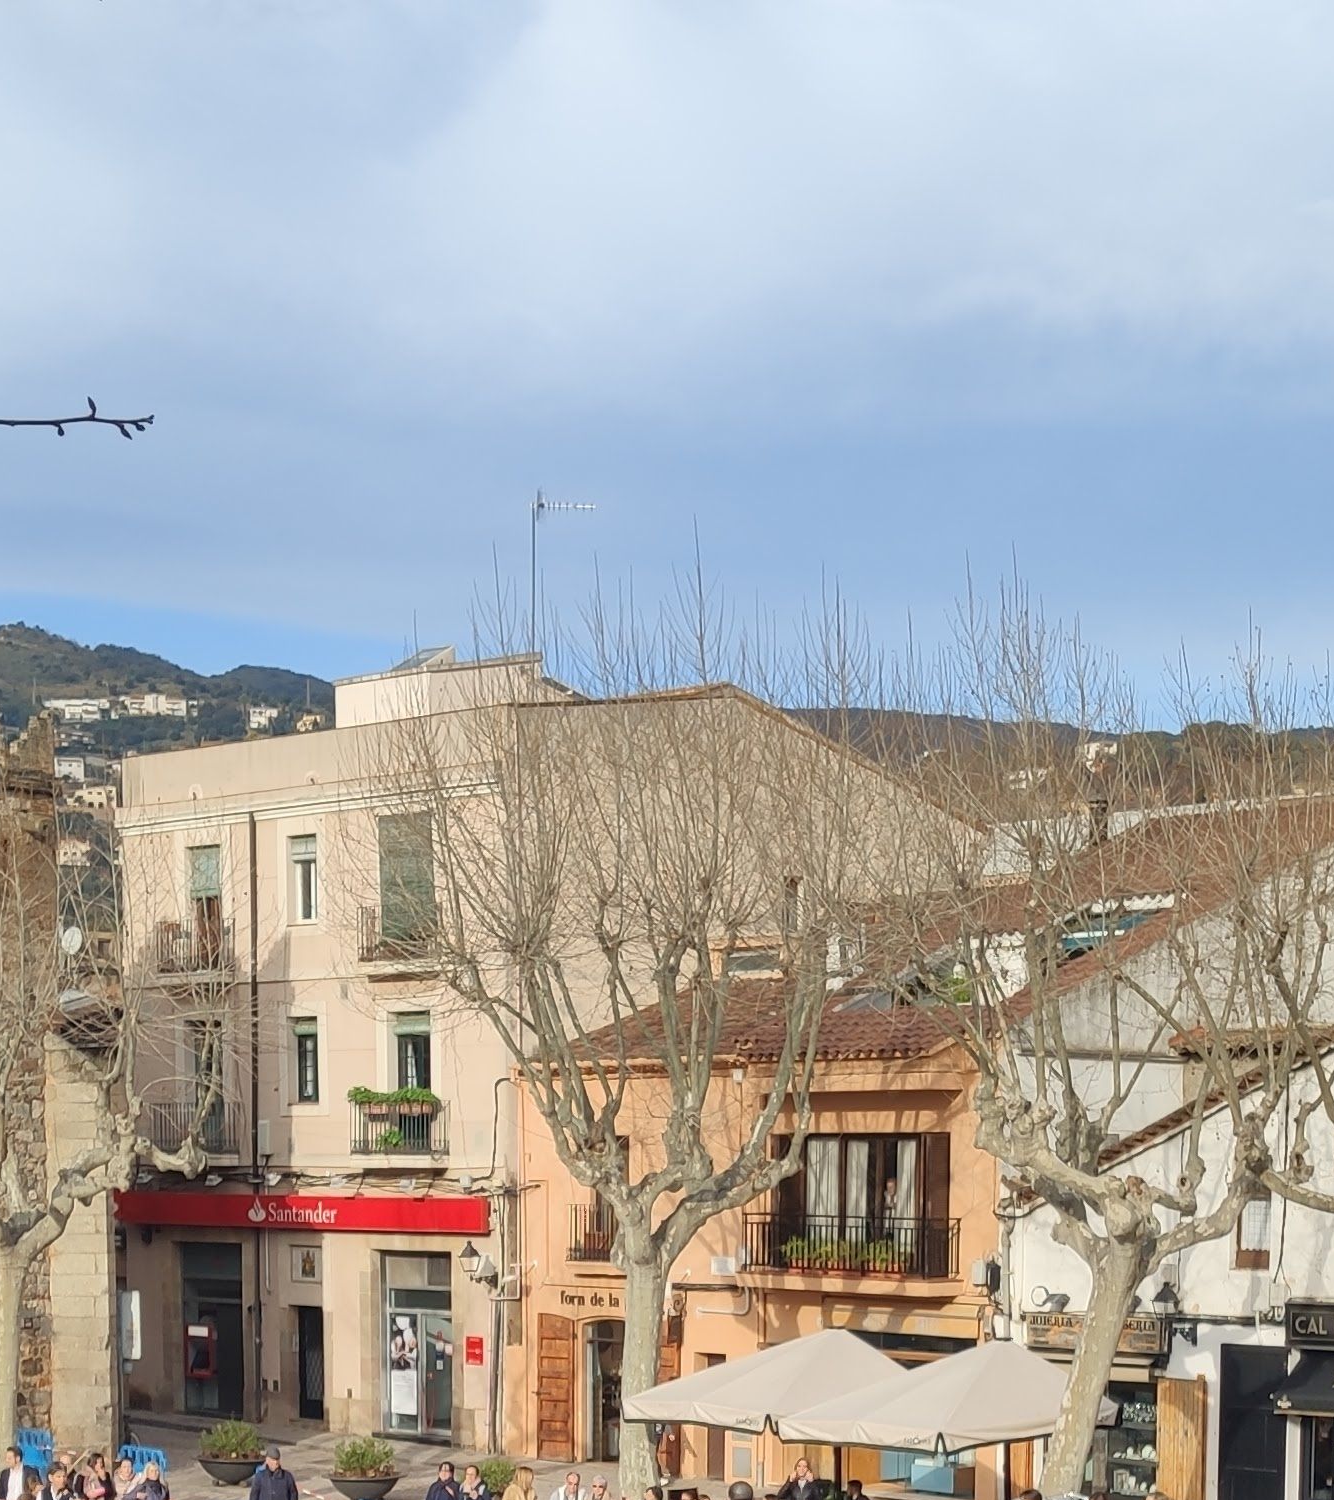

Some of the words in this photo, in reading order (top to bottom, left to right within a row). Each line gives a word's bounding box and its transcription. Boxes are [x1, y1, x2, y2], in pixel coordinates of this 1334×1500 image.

[268, 1200, 338, 1224] Santander
[560, 1290, 585, 1306] forn
[590, 1292, 605, 1307] de
[608, 1292, 620, 1307] la
[1295, 1316, 1327, 1336] CAL
